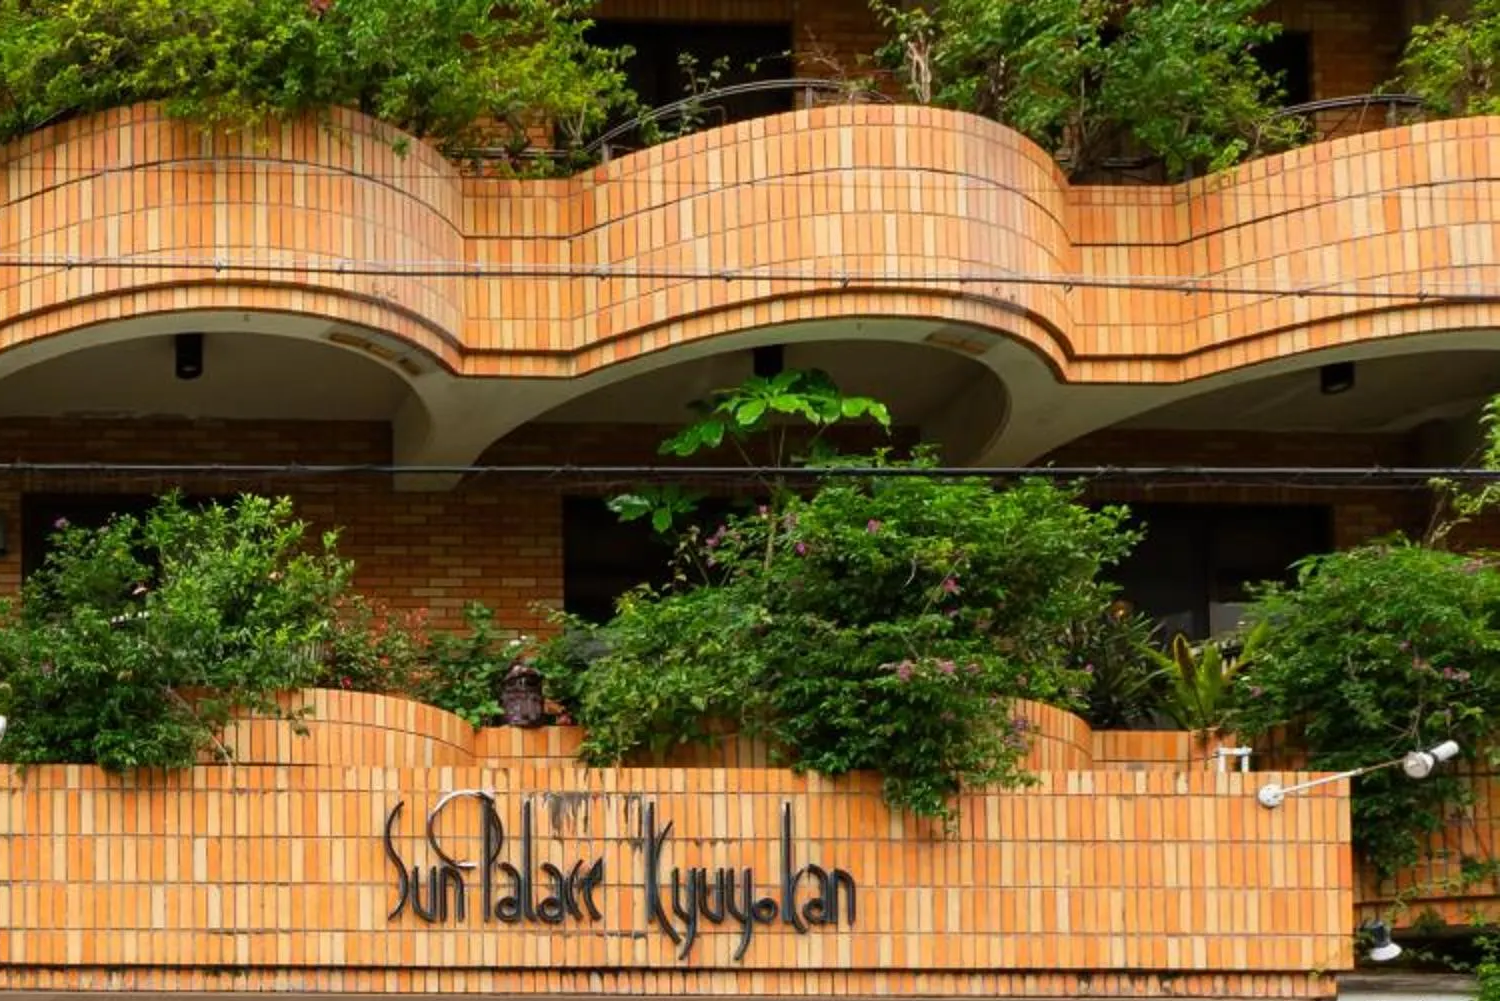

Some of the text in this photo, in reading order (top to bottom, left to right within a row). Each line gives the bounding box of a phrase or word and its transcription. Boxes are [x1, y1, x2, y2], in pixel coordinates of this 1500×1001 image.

[386, 789, 856, 961] Sun Palace Kyuyokan
